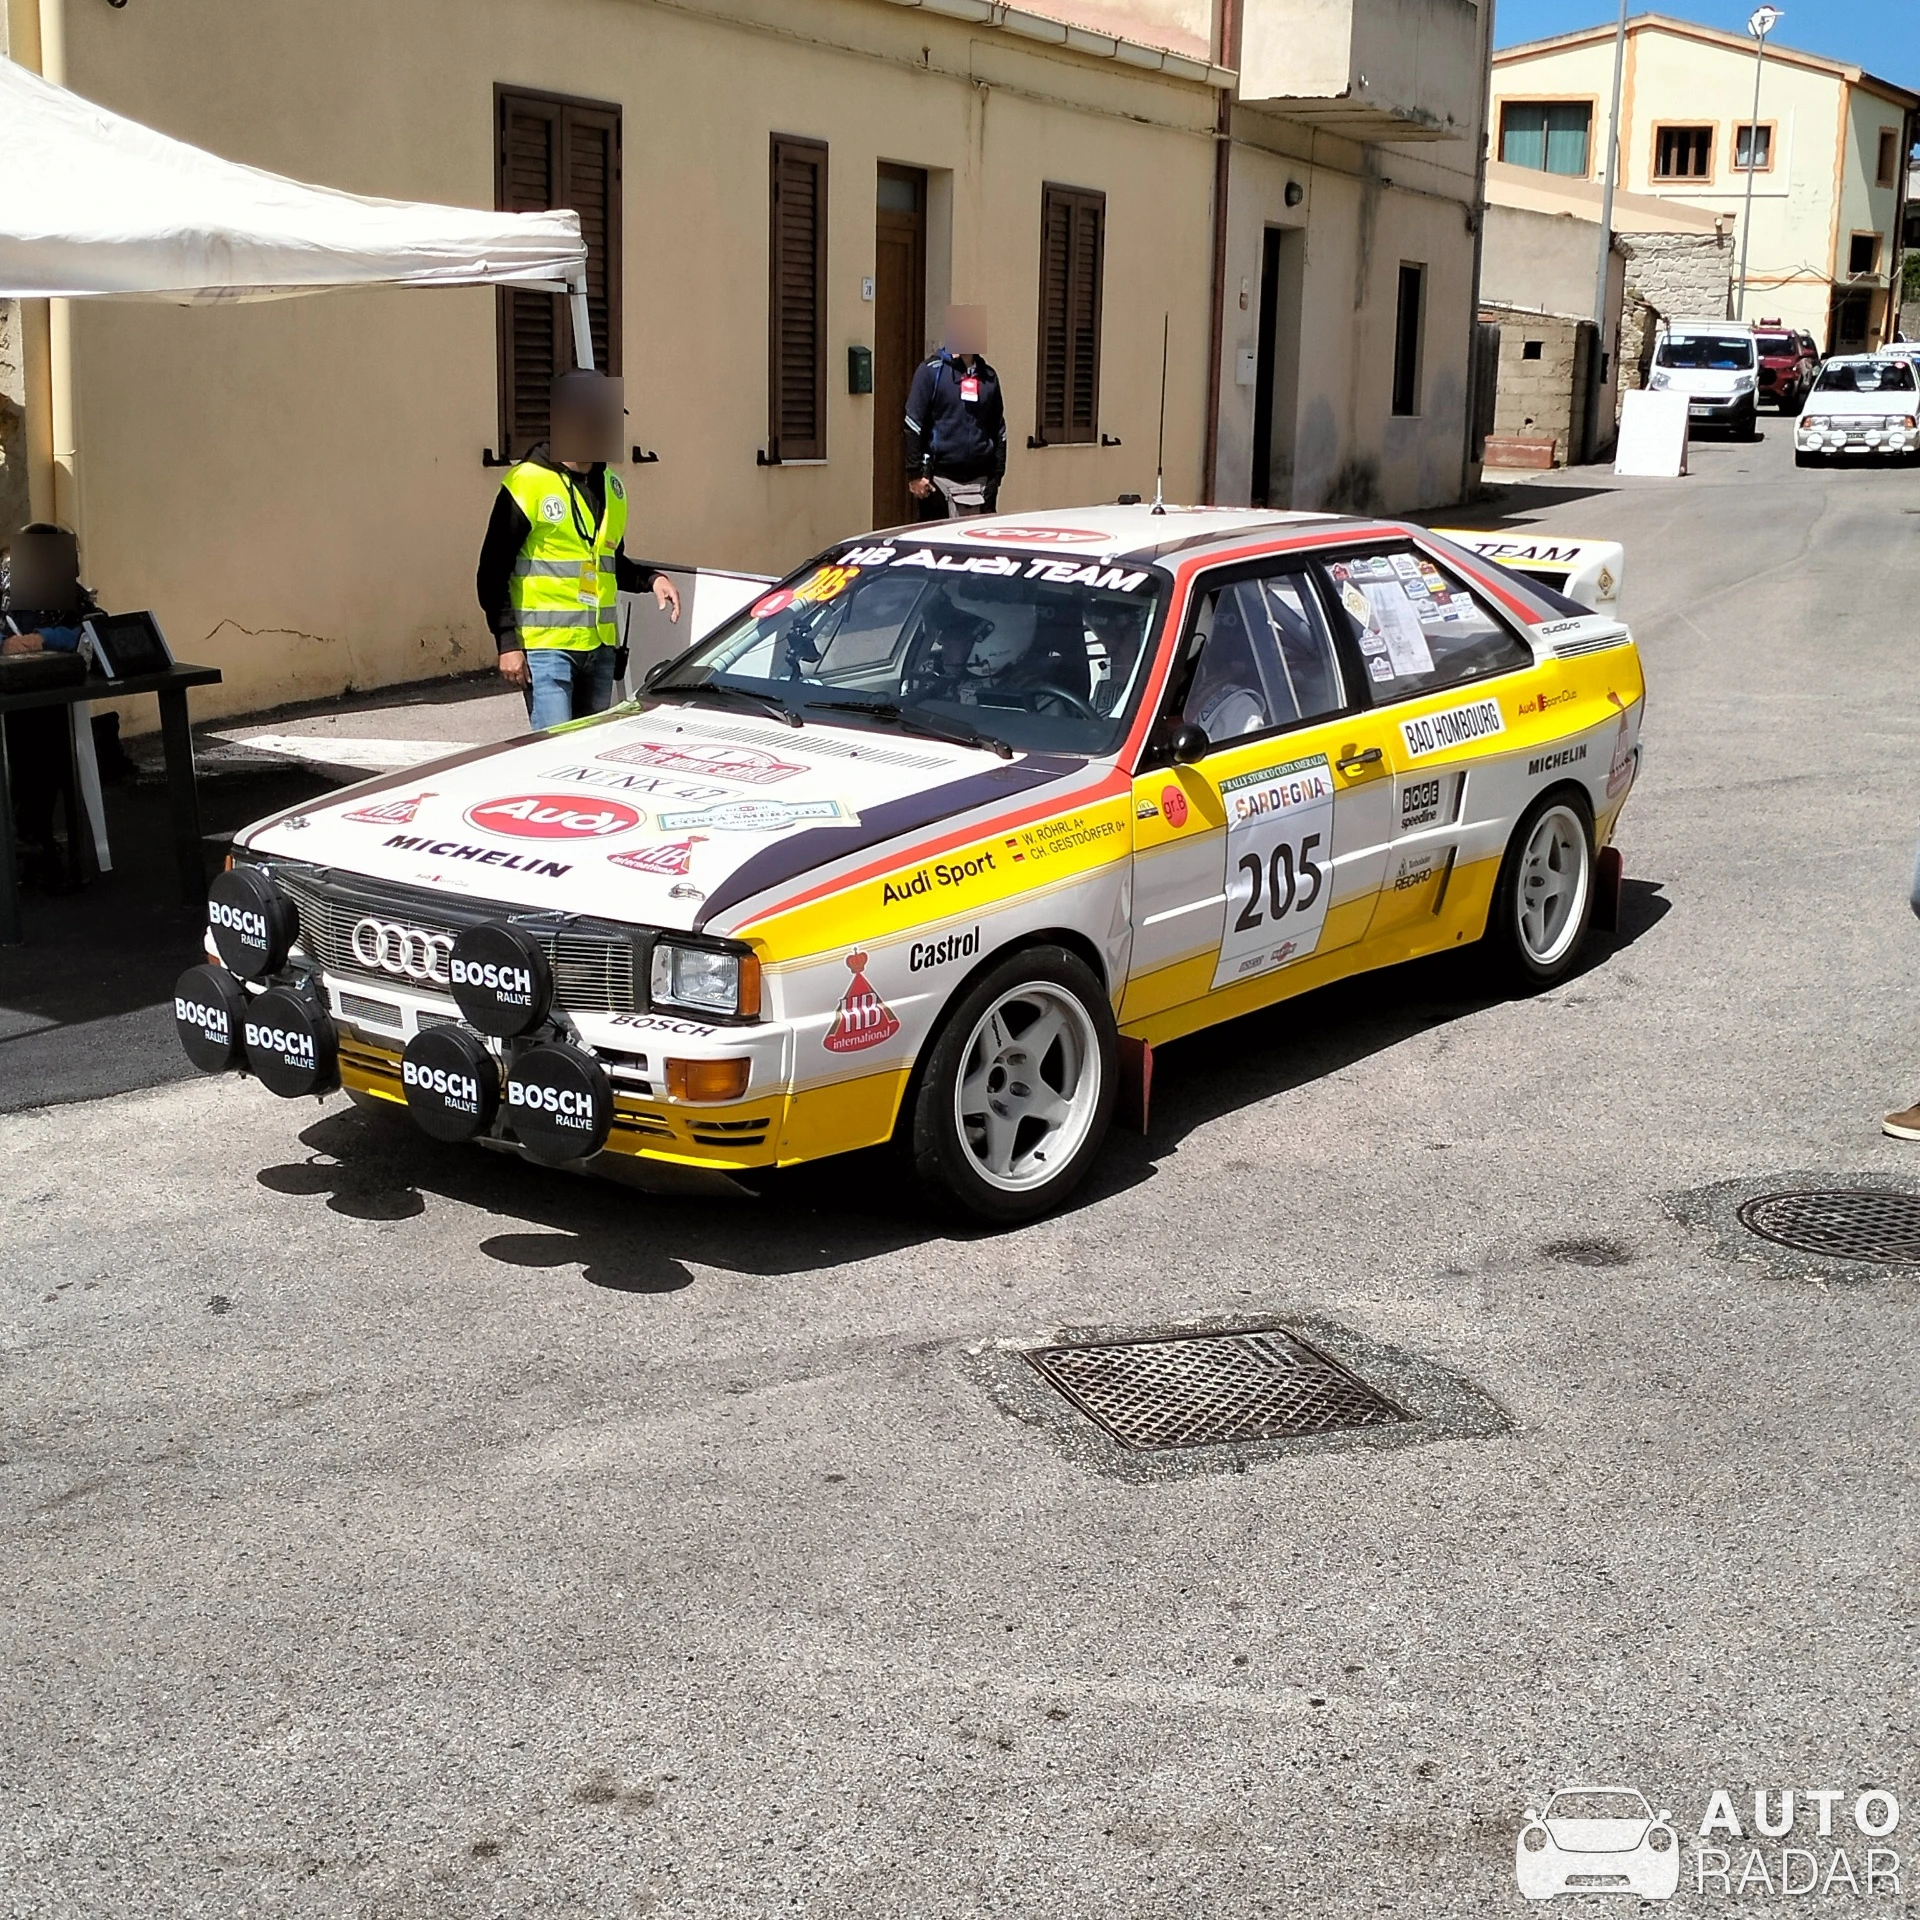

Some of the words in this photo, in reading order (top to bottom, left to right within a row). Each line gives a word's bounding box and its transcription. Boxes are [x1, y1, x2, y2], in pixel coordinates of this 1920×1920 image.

[545, 502, 563, 517] 22
[1473, 543, 1581, 562] TEAM
[793, 566, 861, 602] 205
[837, 547, 896, 566] HB
[890, 549, 1021, 577] Audi
[1024, 558, 1151, 593] TEAM
[1542, 622, 1581, 635] quattro
[1405, 720, 1434, 755] BAD
[1434, 703, 1501, 748] HOMBOURG
[1226, 776, 1249, 791] RALLY
[1248, 766, 1276, 784] STORICO
[1275, 762, 1295, 777] COSTA
[1294, 754, 1328, 770] SMERALDA
[1528, 744, 1587, 775] MICHELIN
[1163, 793, 1186, 819] gr.B
[1236, 777, 1326, 820] SARDEGNA
[1403, 783, 1438, 810] BOGE
[486, 799, 629, 835] Audi
[1401, 809, 1436, 831] speedline
[1021, 832, 1037, 846] W.
[1036, 821, 1073, 841] RÖHRL
[1030, 845, 1050, 860] CH.
[1049, 822, 1116, 853] GEISTDÖRFER
[382, 834, 574, 879] MICHELIN
[632, 845, 690, 867] HB
[882, 869, 933, 906] Audi
[934, 851, 997, 887] Sport
[1234, 833, 1322, 933] 205
[1394, 868, 1431, 892] RECARO
[208, 901, 266, 938] BOSCH
[241, 933, 267, 950] RALLYE
[909, 925, 980, 973] Castrol
[451, 959, 531, 993] BOSCH
[496, 991, 532, 1006] RALLYE
[840, 992, 882, 1033] HB
[175, 997, 228, 1033] BOSCH
[610, 1015, 719, 1038] BOSCH
[205, 1030, 229, 1046] RALLYE
[245, 1023, 314, 1057] BOSCH
[833, 1026, 890, 1050] international
[284, 1054, 315, 1070] RALLYE
[402, 1061, 478, 1101] BOSCH
[444, 1096, 478, 1114] RALLYE
[508, 1081, 593, 1118] BOSCH
[555, 1113, 593, 1131] RALLYE
